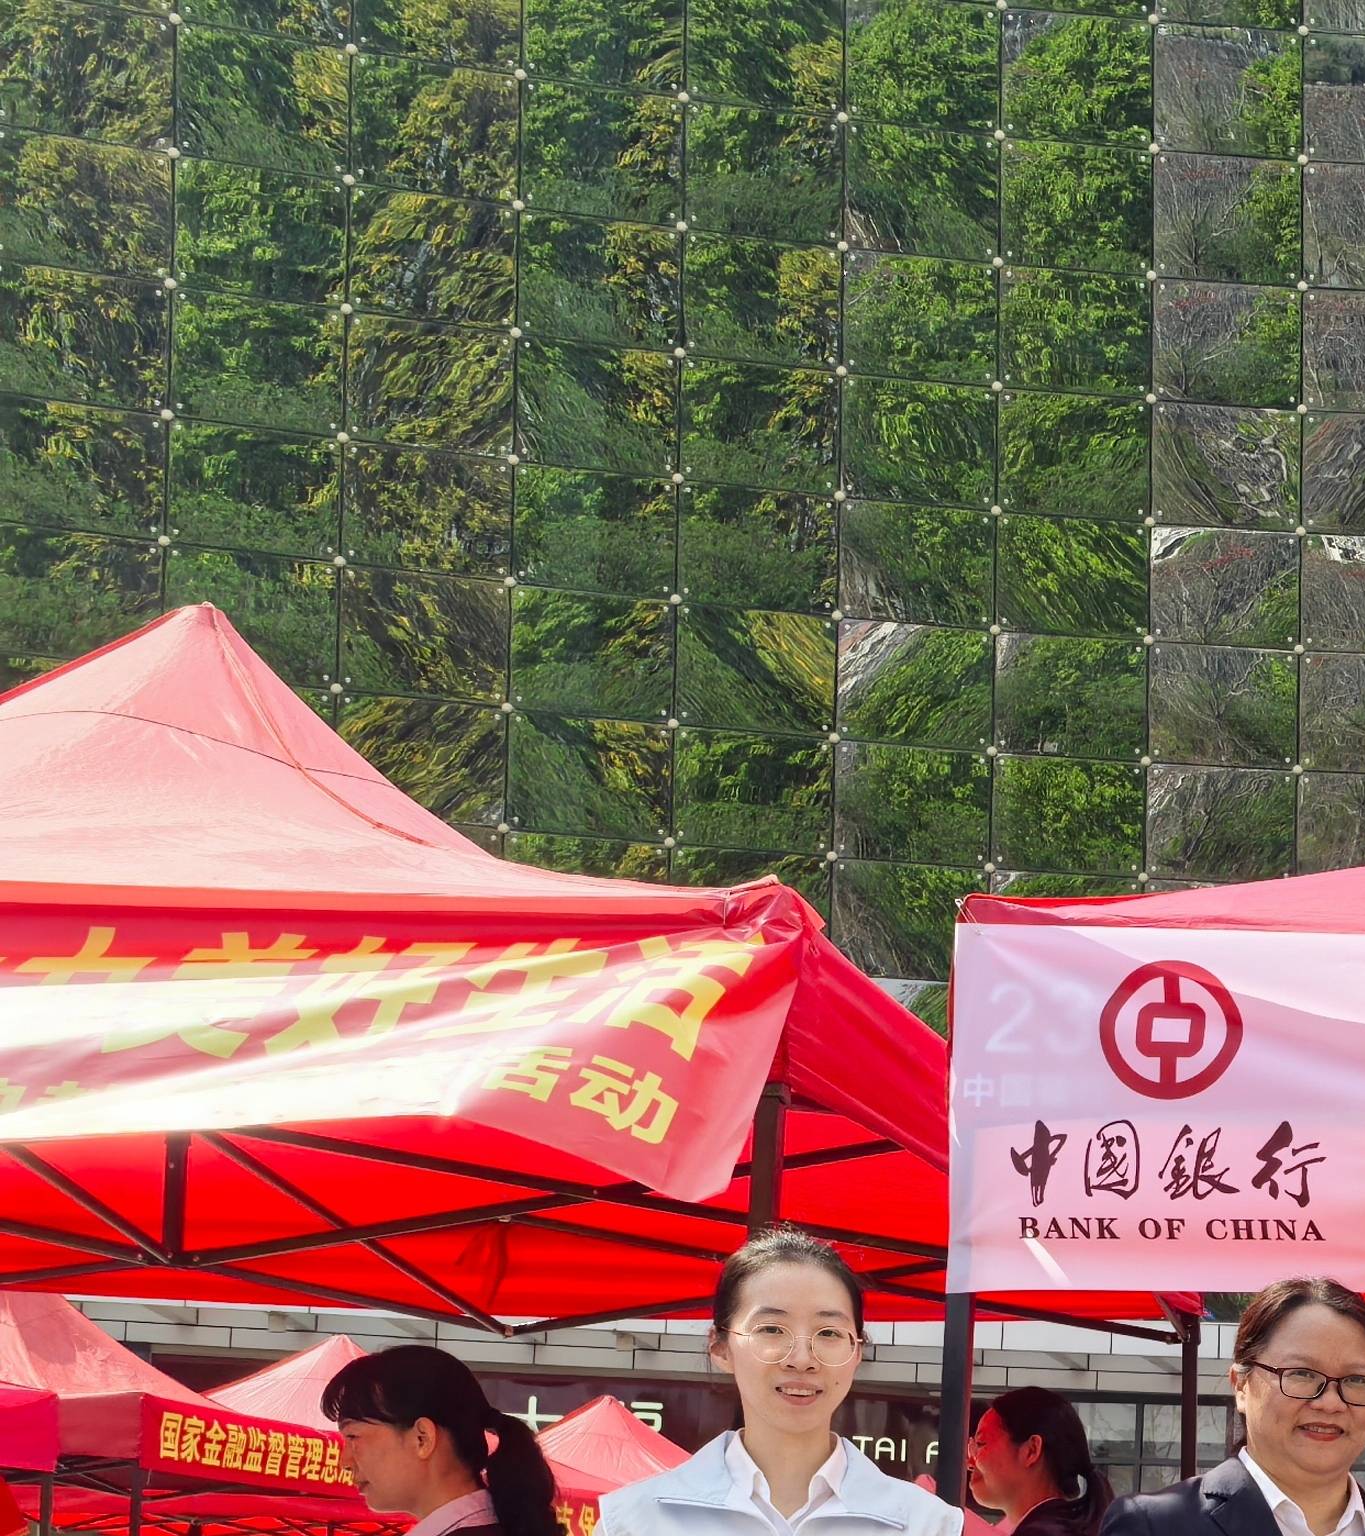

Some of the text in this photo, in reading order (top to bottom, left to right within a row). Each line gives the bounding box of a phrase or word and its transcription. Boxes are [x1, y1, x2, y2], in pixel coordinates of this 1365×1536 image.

[1018, 1217, 1327, 1241] BANK OF CHINA
